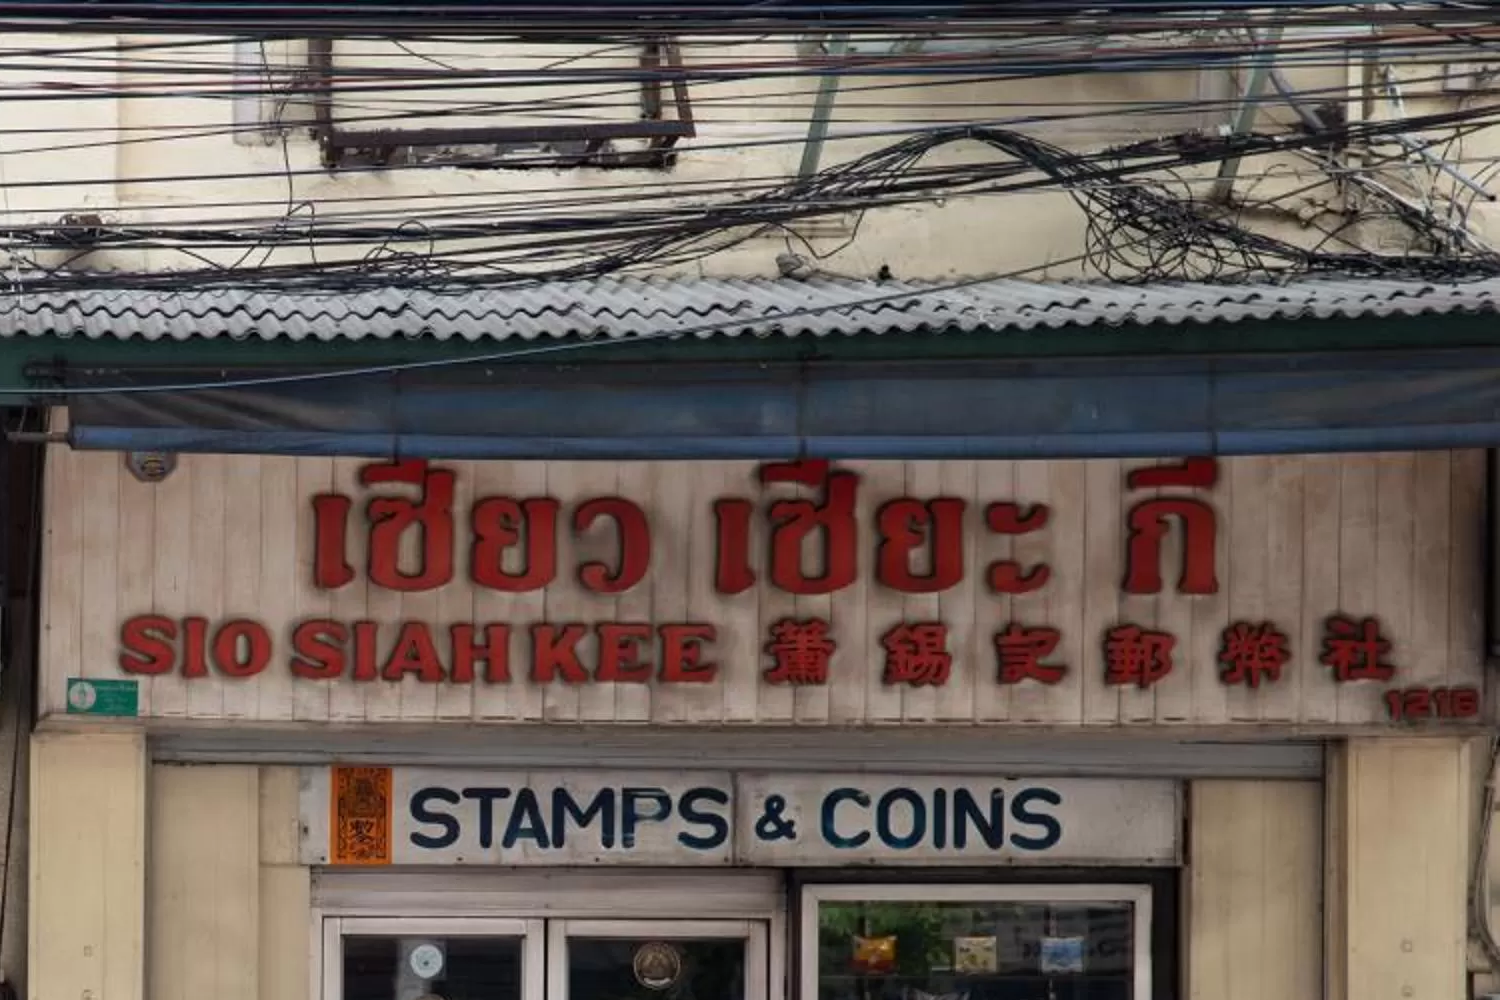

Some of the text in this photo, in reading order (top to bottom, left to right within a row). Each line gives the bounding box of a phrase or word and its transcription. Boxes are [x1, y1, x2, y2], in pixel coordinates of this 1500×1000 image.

[119, 615, 717, 684] SIO SIAH KEE
[409, 786, 731, 850] STAMPS
[754, 794, 797, 841] &
[820, 787, 1063, 852] COINS
